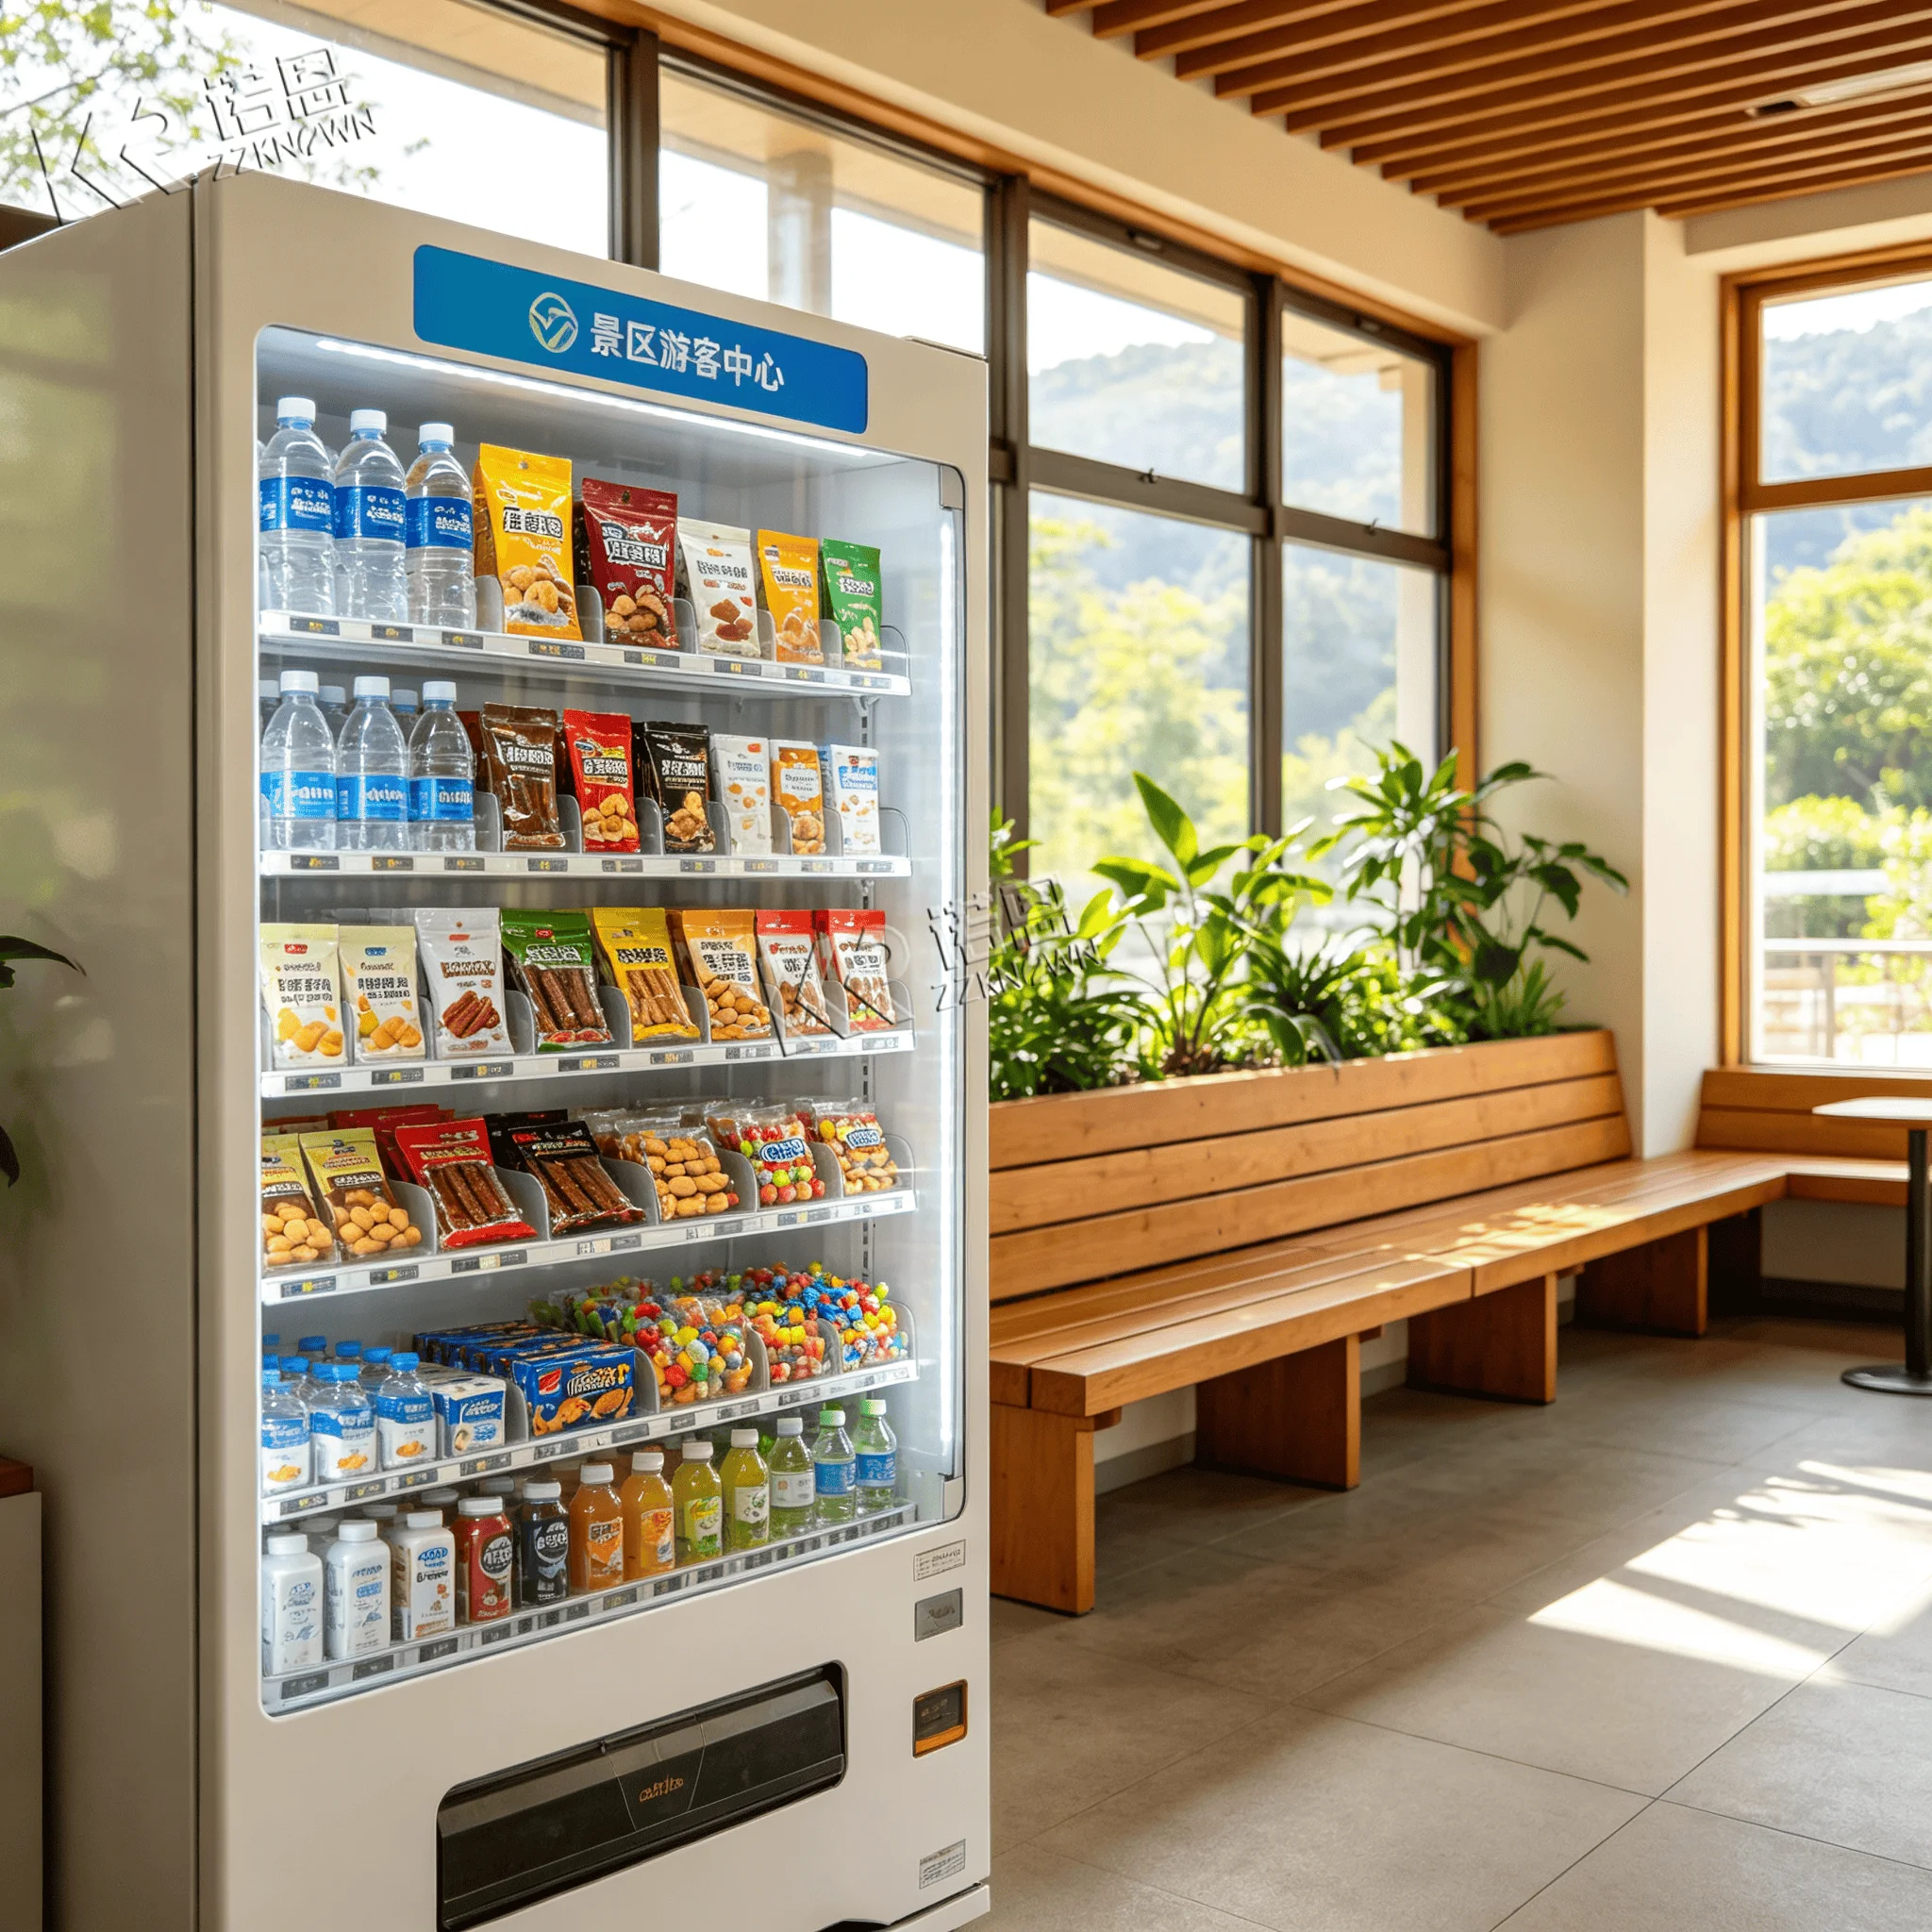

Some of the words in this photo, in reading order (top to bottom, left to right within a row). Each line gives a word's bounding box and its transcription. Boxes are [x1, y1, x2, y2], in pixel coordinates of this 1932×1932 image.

[591, 312, 785, 392] 景区游客中心
